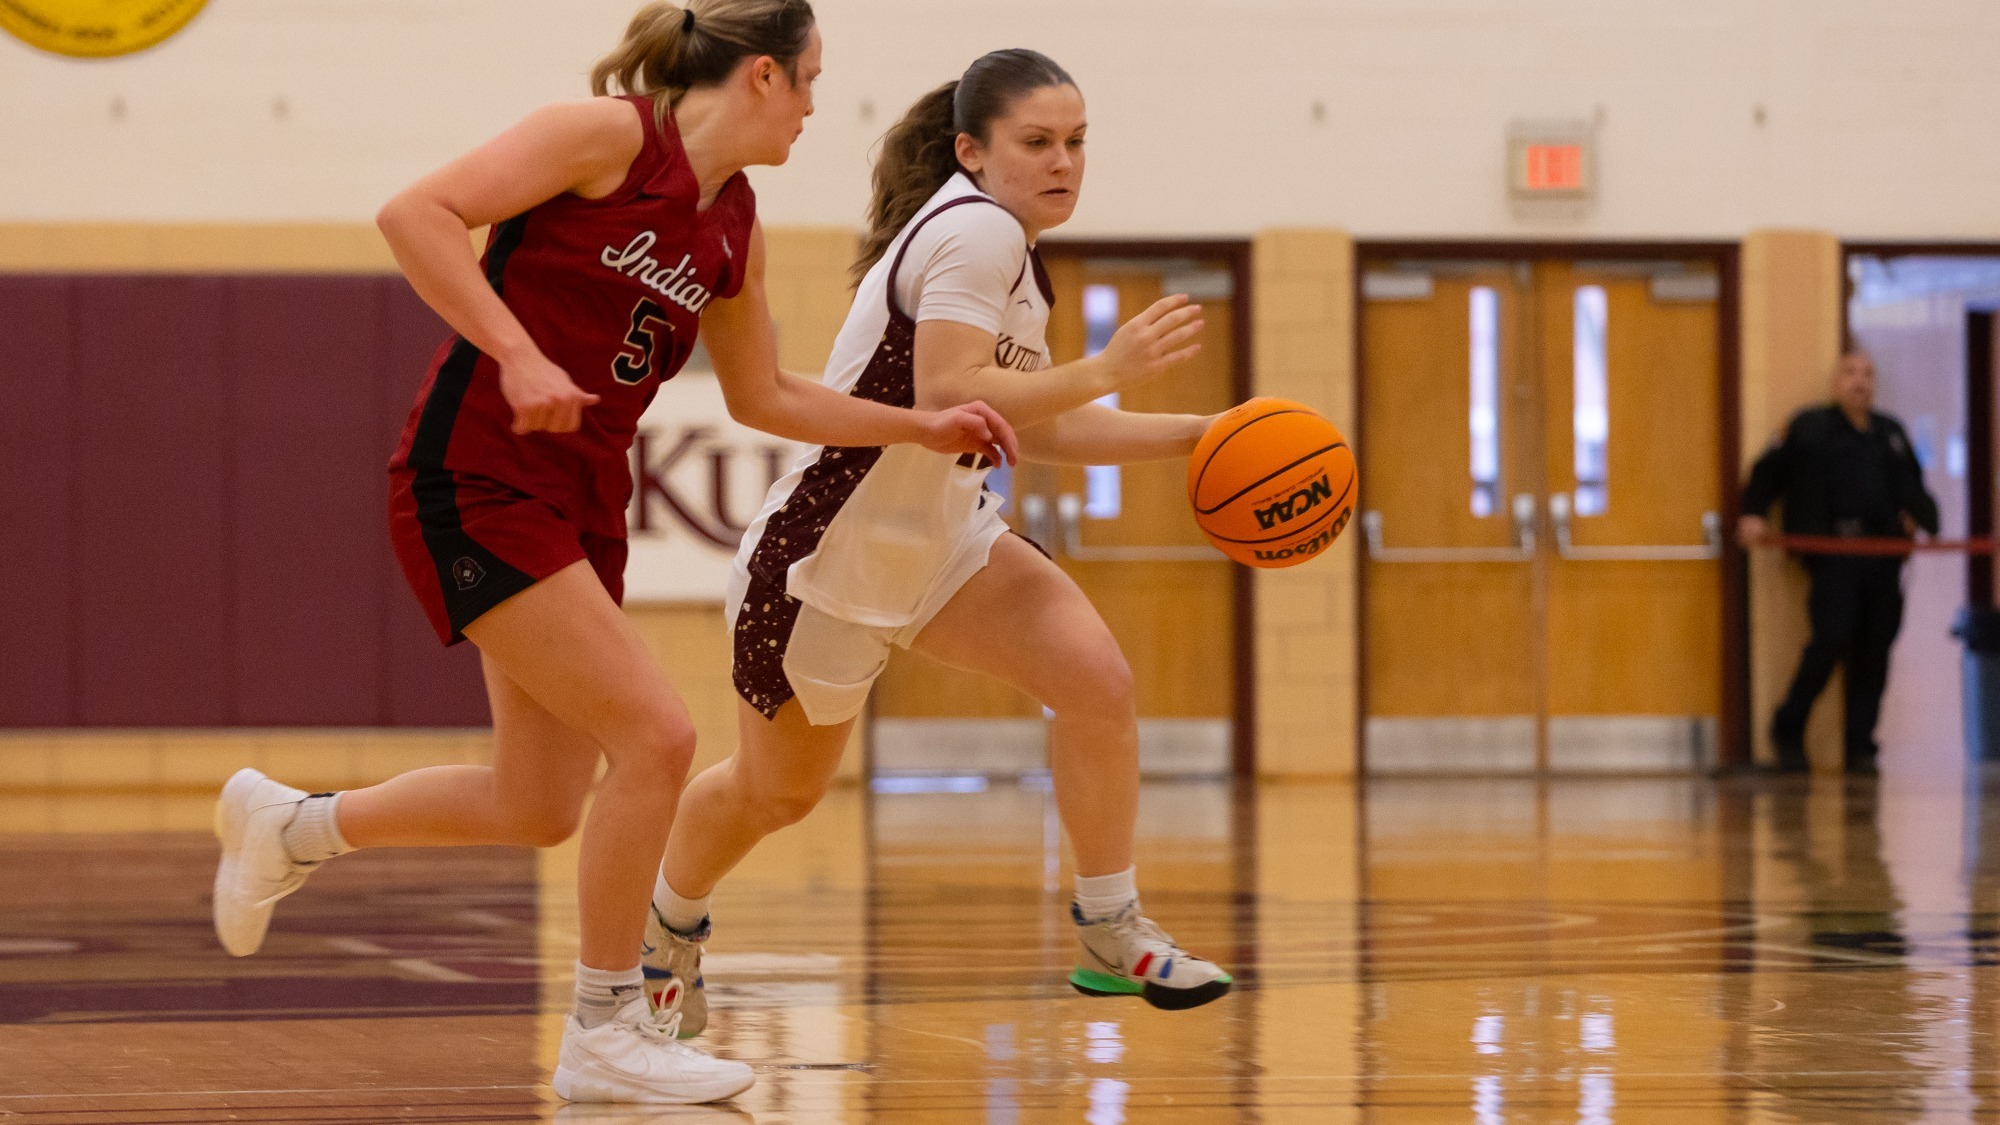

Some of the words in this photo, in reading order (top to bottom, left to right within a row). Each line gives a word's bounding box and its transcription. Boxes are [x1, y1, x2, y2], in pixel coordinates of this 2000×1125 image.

[611, 296, 676, 386] 5
[1253, 472, 1332, 531] NCAA
[1253, 505, 1352, 561] Wilson
